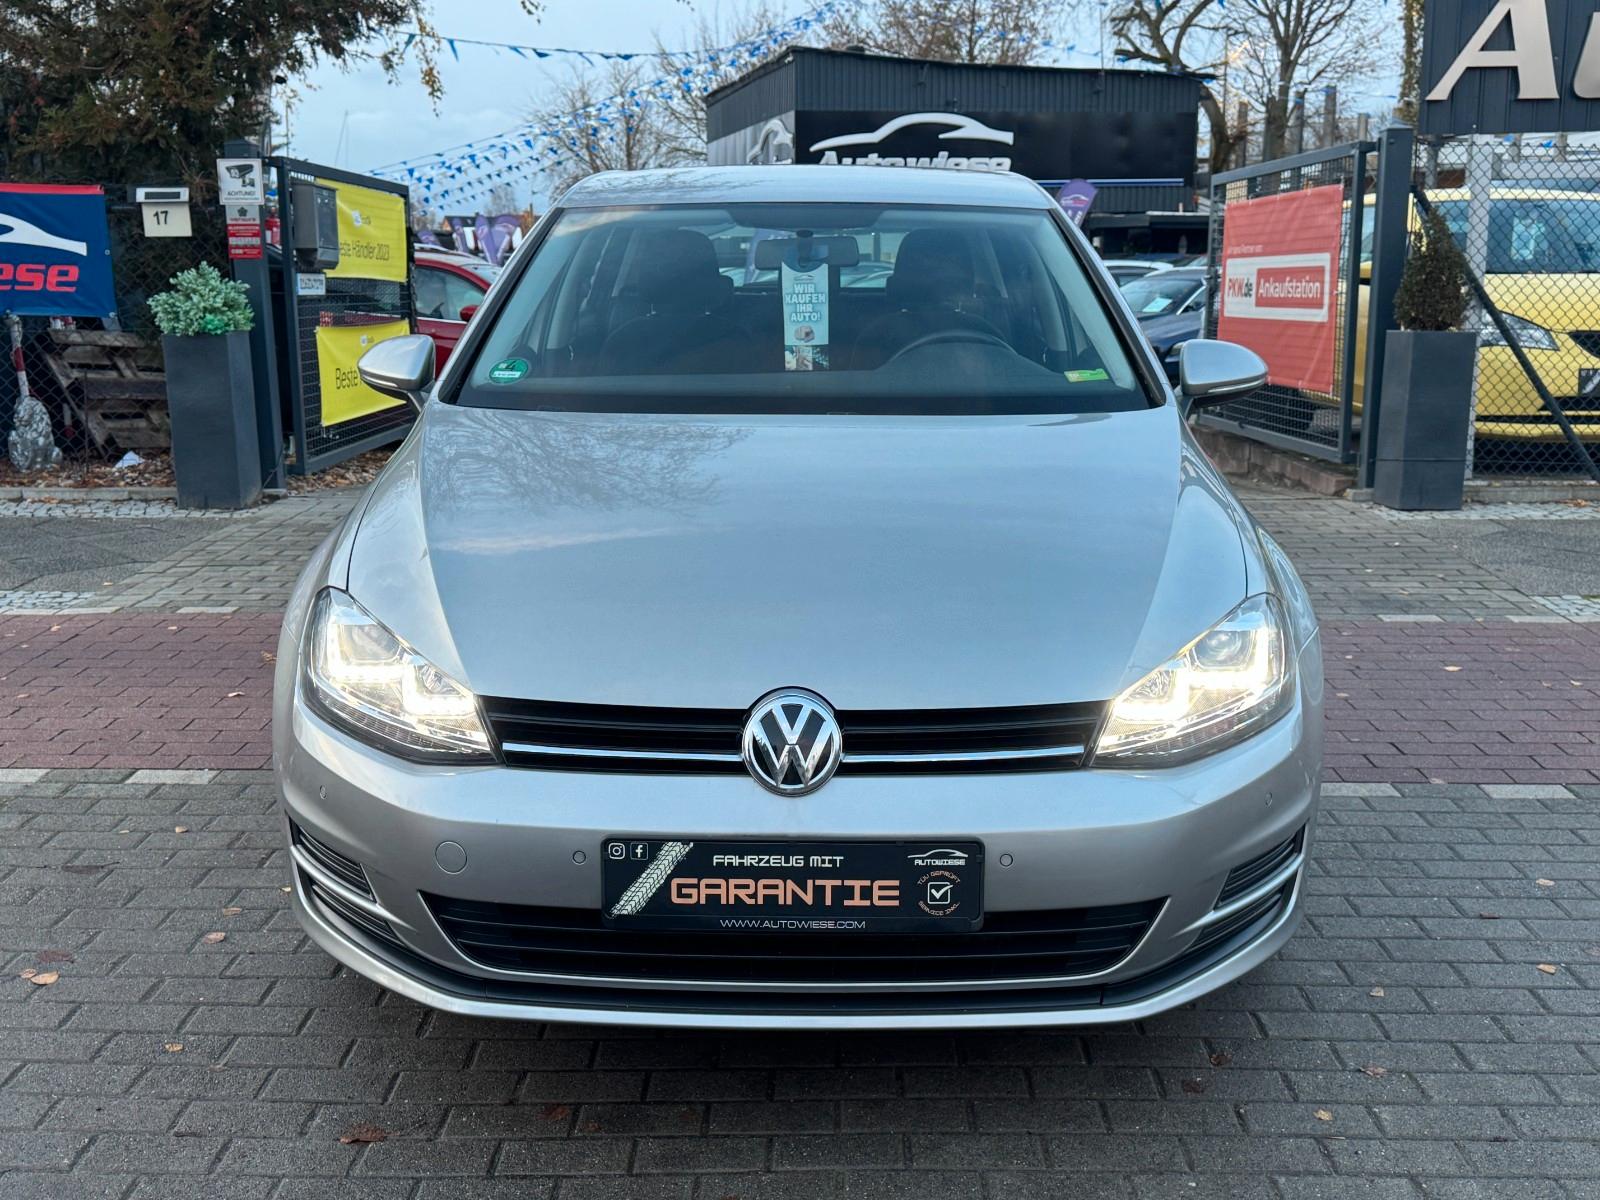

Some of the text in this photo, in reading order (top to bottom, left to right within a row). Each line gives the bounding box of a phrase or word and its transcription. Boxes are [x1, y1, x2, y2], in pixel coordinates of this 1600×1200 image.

[1425, 0, 1600, 101] A
[153, 210, 169, 226] 17
[794, 284, 815, 293] WIR
[1227, 276, 1320, 299] PKW.de Ankaufstation
[785, 294, 826, 304] KAUFEN
[797, 304, 813, 312] IHR
[791, 312, 821, 321] AUTO!
[335, 367, 359, 390] Beste
[746, 697, 838, 790] VW
[713, 855, 844, 868] FAHRZEUG MIT
[671, 877, 900, 907] GARANTIE
[719, 919, 867, 930] WWW.AUTOWIESE.COM
